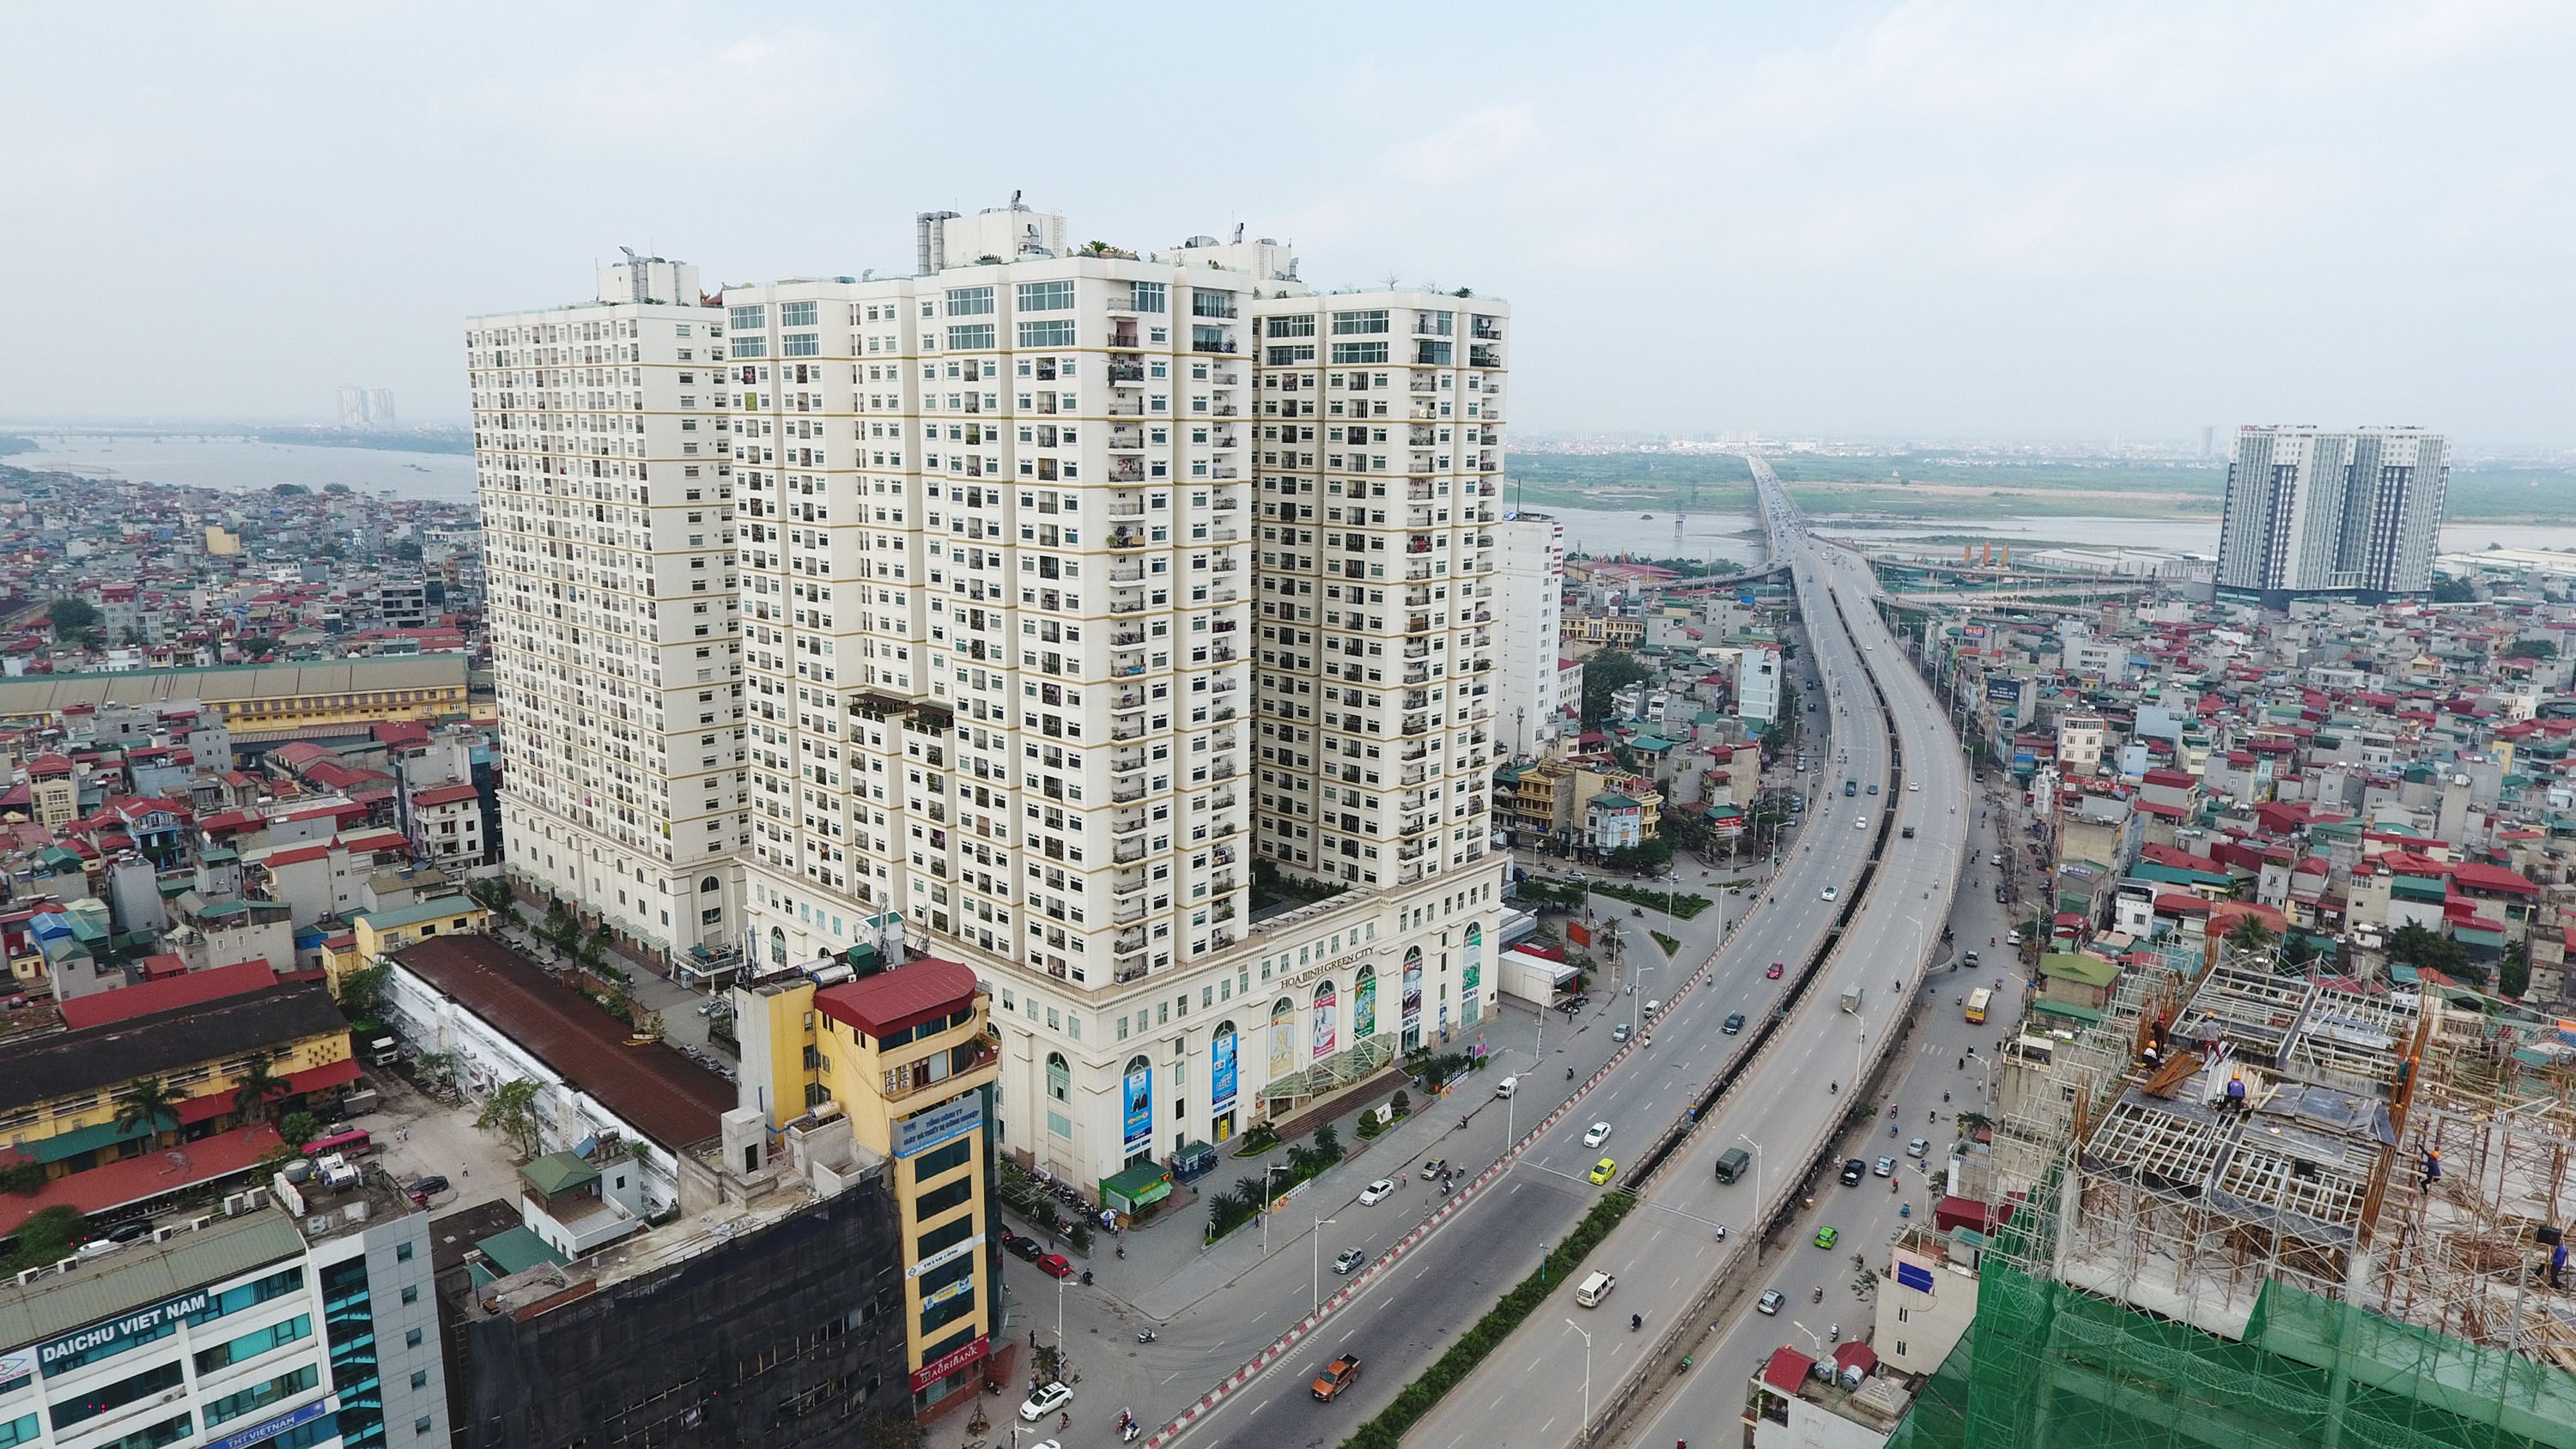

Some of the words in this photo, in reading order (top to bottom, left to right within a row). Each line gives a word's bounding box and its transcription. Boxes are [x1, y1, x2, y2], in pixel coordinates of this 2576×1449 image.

[1324, 953, 1355, 972] GREEN
[1355, 946, 1375, 960] CITY
[43, 1325, 115, 1363] DAICHU
[119, 1309, 161, 1336] VIET
[166, 1294, 206, 1320] NAM
[931, 1345, 978, 1379] AGRIBANK
[249, 1416, 295, 1440] VIETNAM
